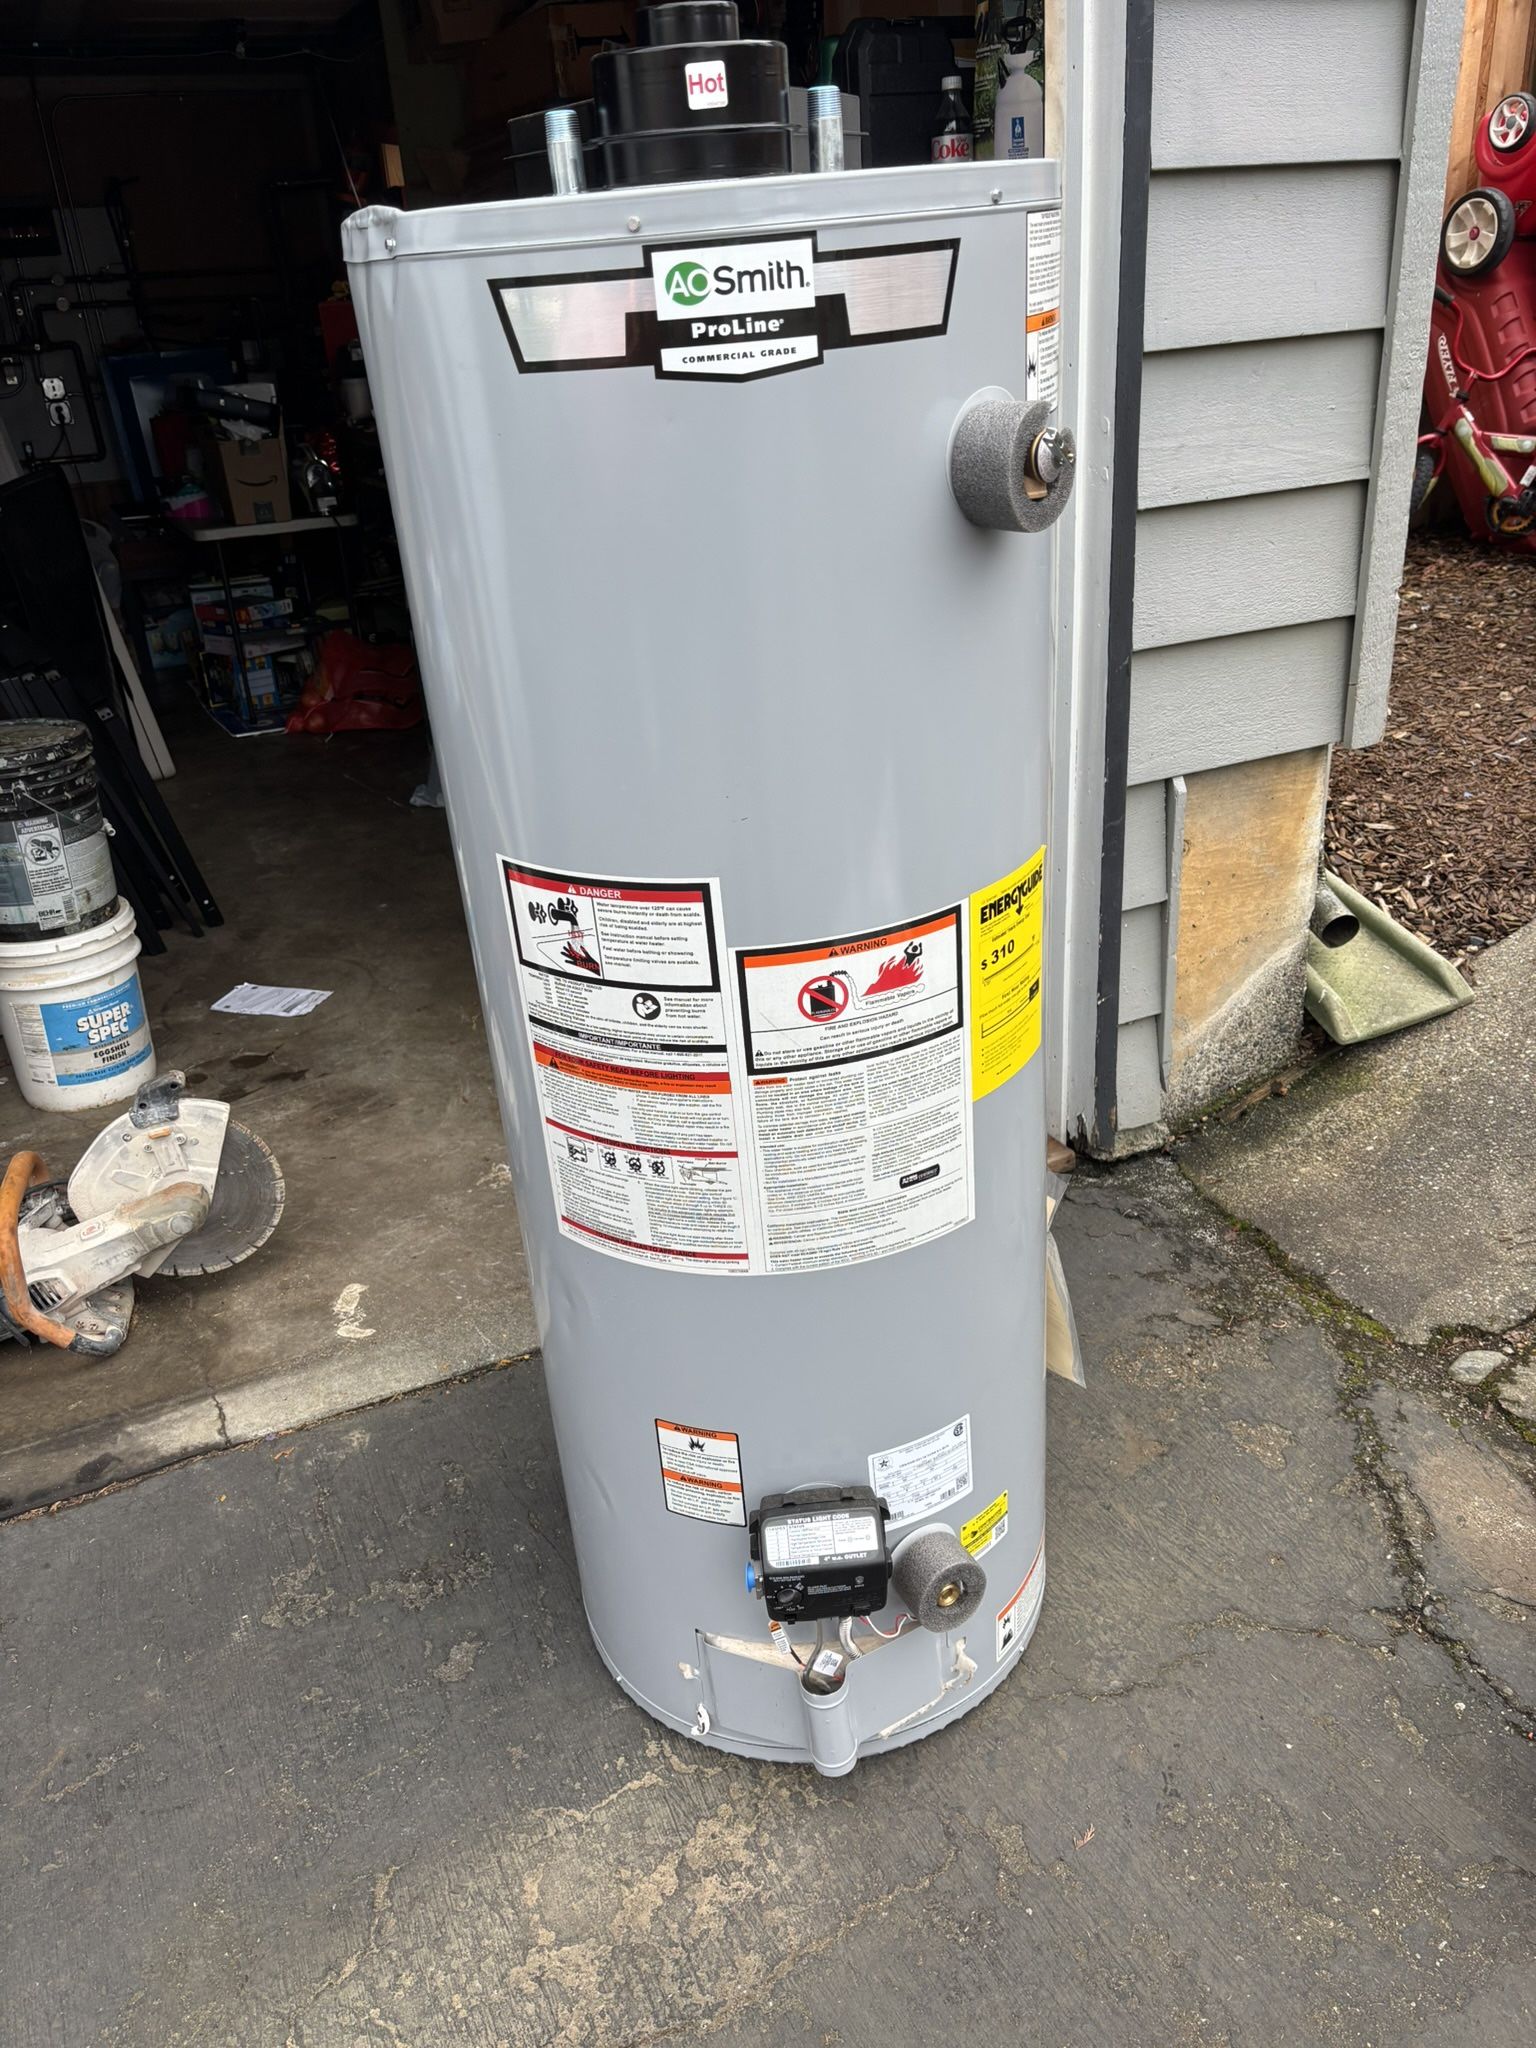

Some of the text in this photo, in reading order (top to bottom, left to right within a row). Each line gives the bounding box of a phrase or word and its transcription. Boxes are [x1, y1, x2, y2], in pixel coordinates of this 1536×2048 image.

[689, 72, 725, 95] Hot
[932, 139, 969, 160] Coke
[668, 260, 805, 298] AO Smith
[691, 317, 780, 339] ProLine
[682, 347, 797, 364] COMMERCIAL GRADE
[1438, 335, 1457, 384] FLYER
[580, 887, 622, 898] DANGER
[980, 863, 1042, 925] ENERGYGUIDE
[840, 938, 887, 954] WARNING
[991, 939, 1015, 964] 310
[865, 990, 915, 1005] Flammable Vapors
[77, 1002, 131, 1032] SUPER
[850, 1016, 878, 1027] EXPLOSION
[856, 1033, 880, 1041] flammable
[881, 1029, 896, 1037] vapors
[935, 1012, 948, 1020] vicinity
[88, 1018, 129, 1044] SPEC
[852, 1028, 869, 1036] serious
[872, 1036, 892, 1045] gasoline
[911, 1023, 933, 1033] flammable
[94, 1040, 130, 1058] EGGSHELL
[856, 1045, 878, 1054] appliance
[908, 1032, 923, 1040] serious
[102, 1050, 127, 1063] FINISH
[631, 1067, 659, 1079] BEFORE
[661, 1072, 695, 1081] LIGHTING
[682, 1427, 717, 1438] WARNING
[688, 1477, 723, 1488] WARNING
[787, 1517, 811, 1525] STATUS
